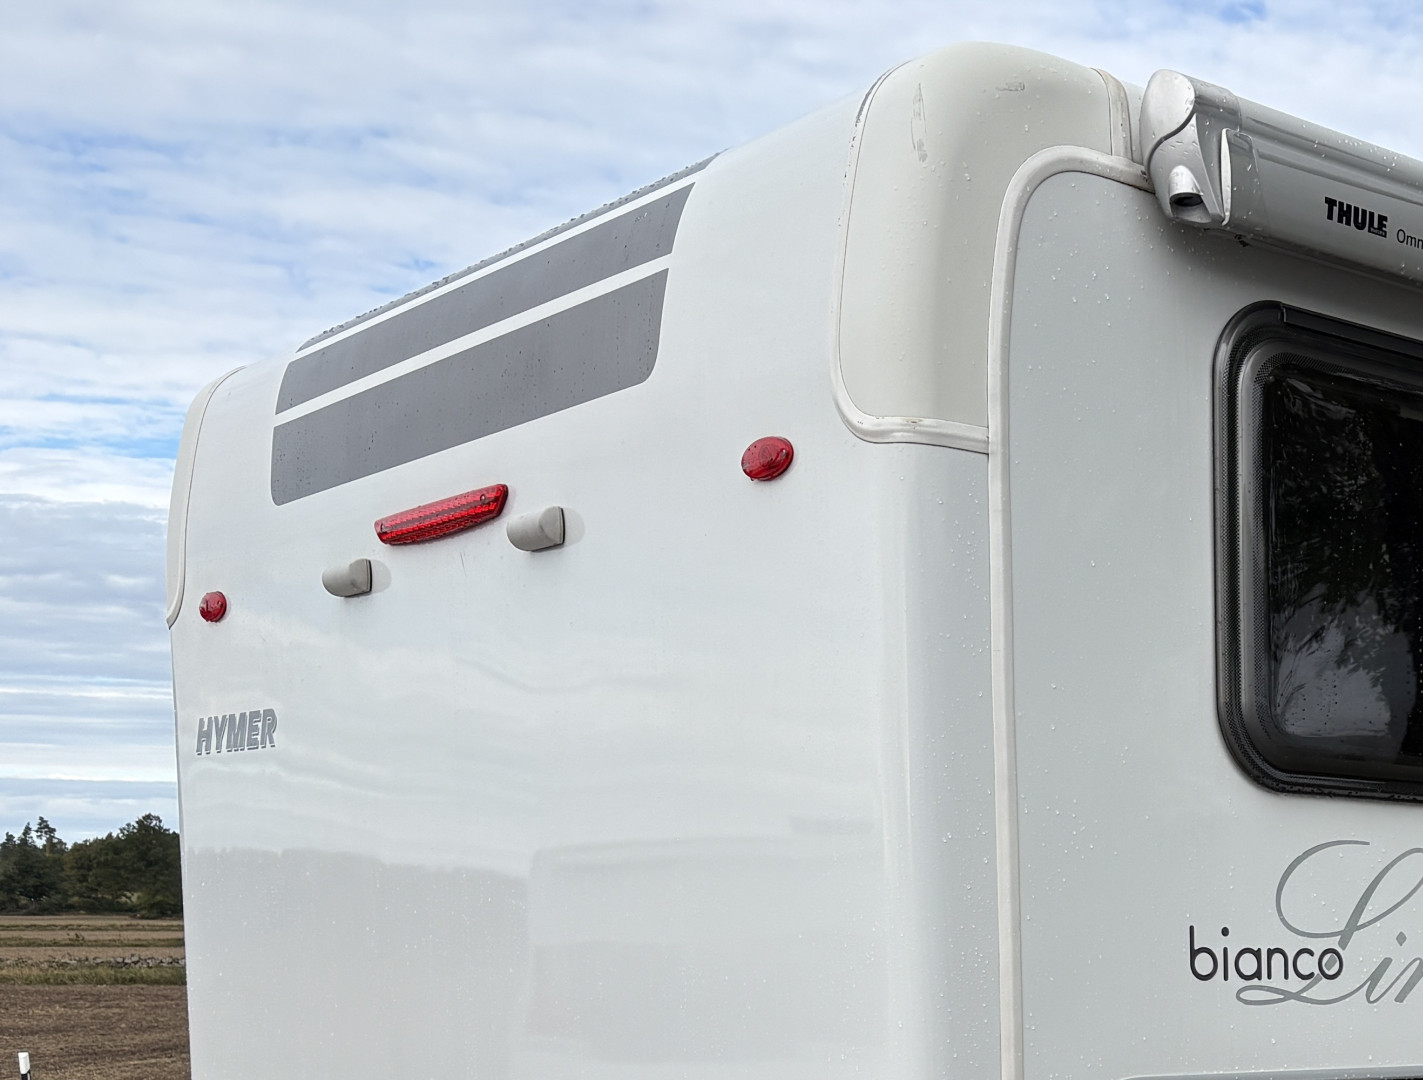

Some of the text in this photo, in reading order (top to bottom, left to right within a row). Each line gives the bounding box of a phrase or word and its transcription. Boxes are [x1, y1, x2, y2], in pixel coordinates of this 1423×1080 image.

[1324, 196, 1388, 238] THULE
[196, 708, 278, 756] HYMER
[1189, 925, 1344, 982] bianco
